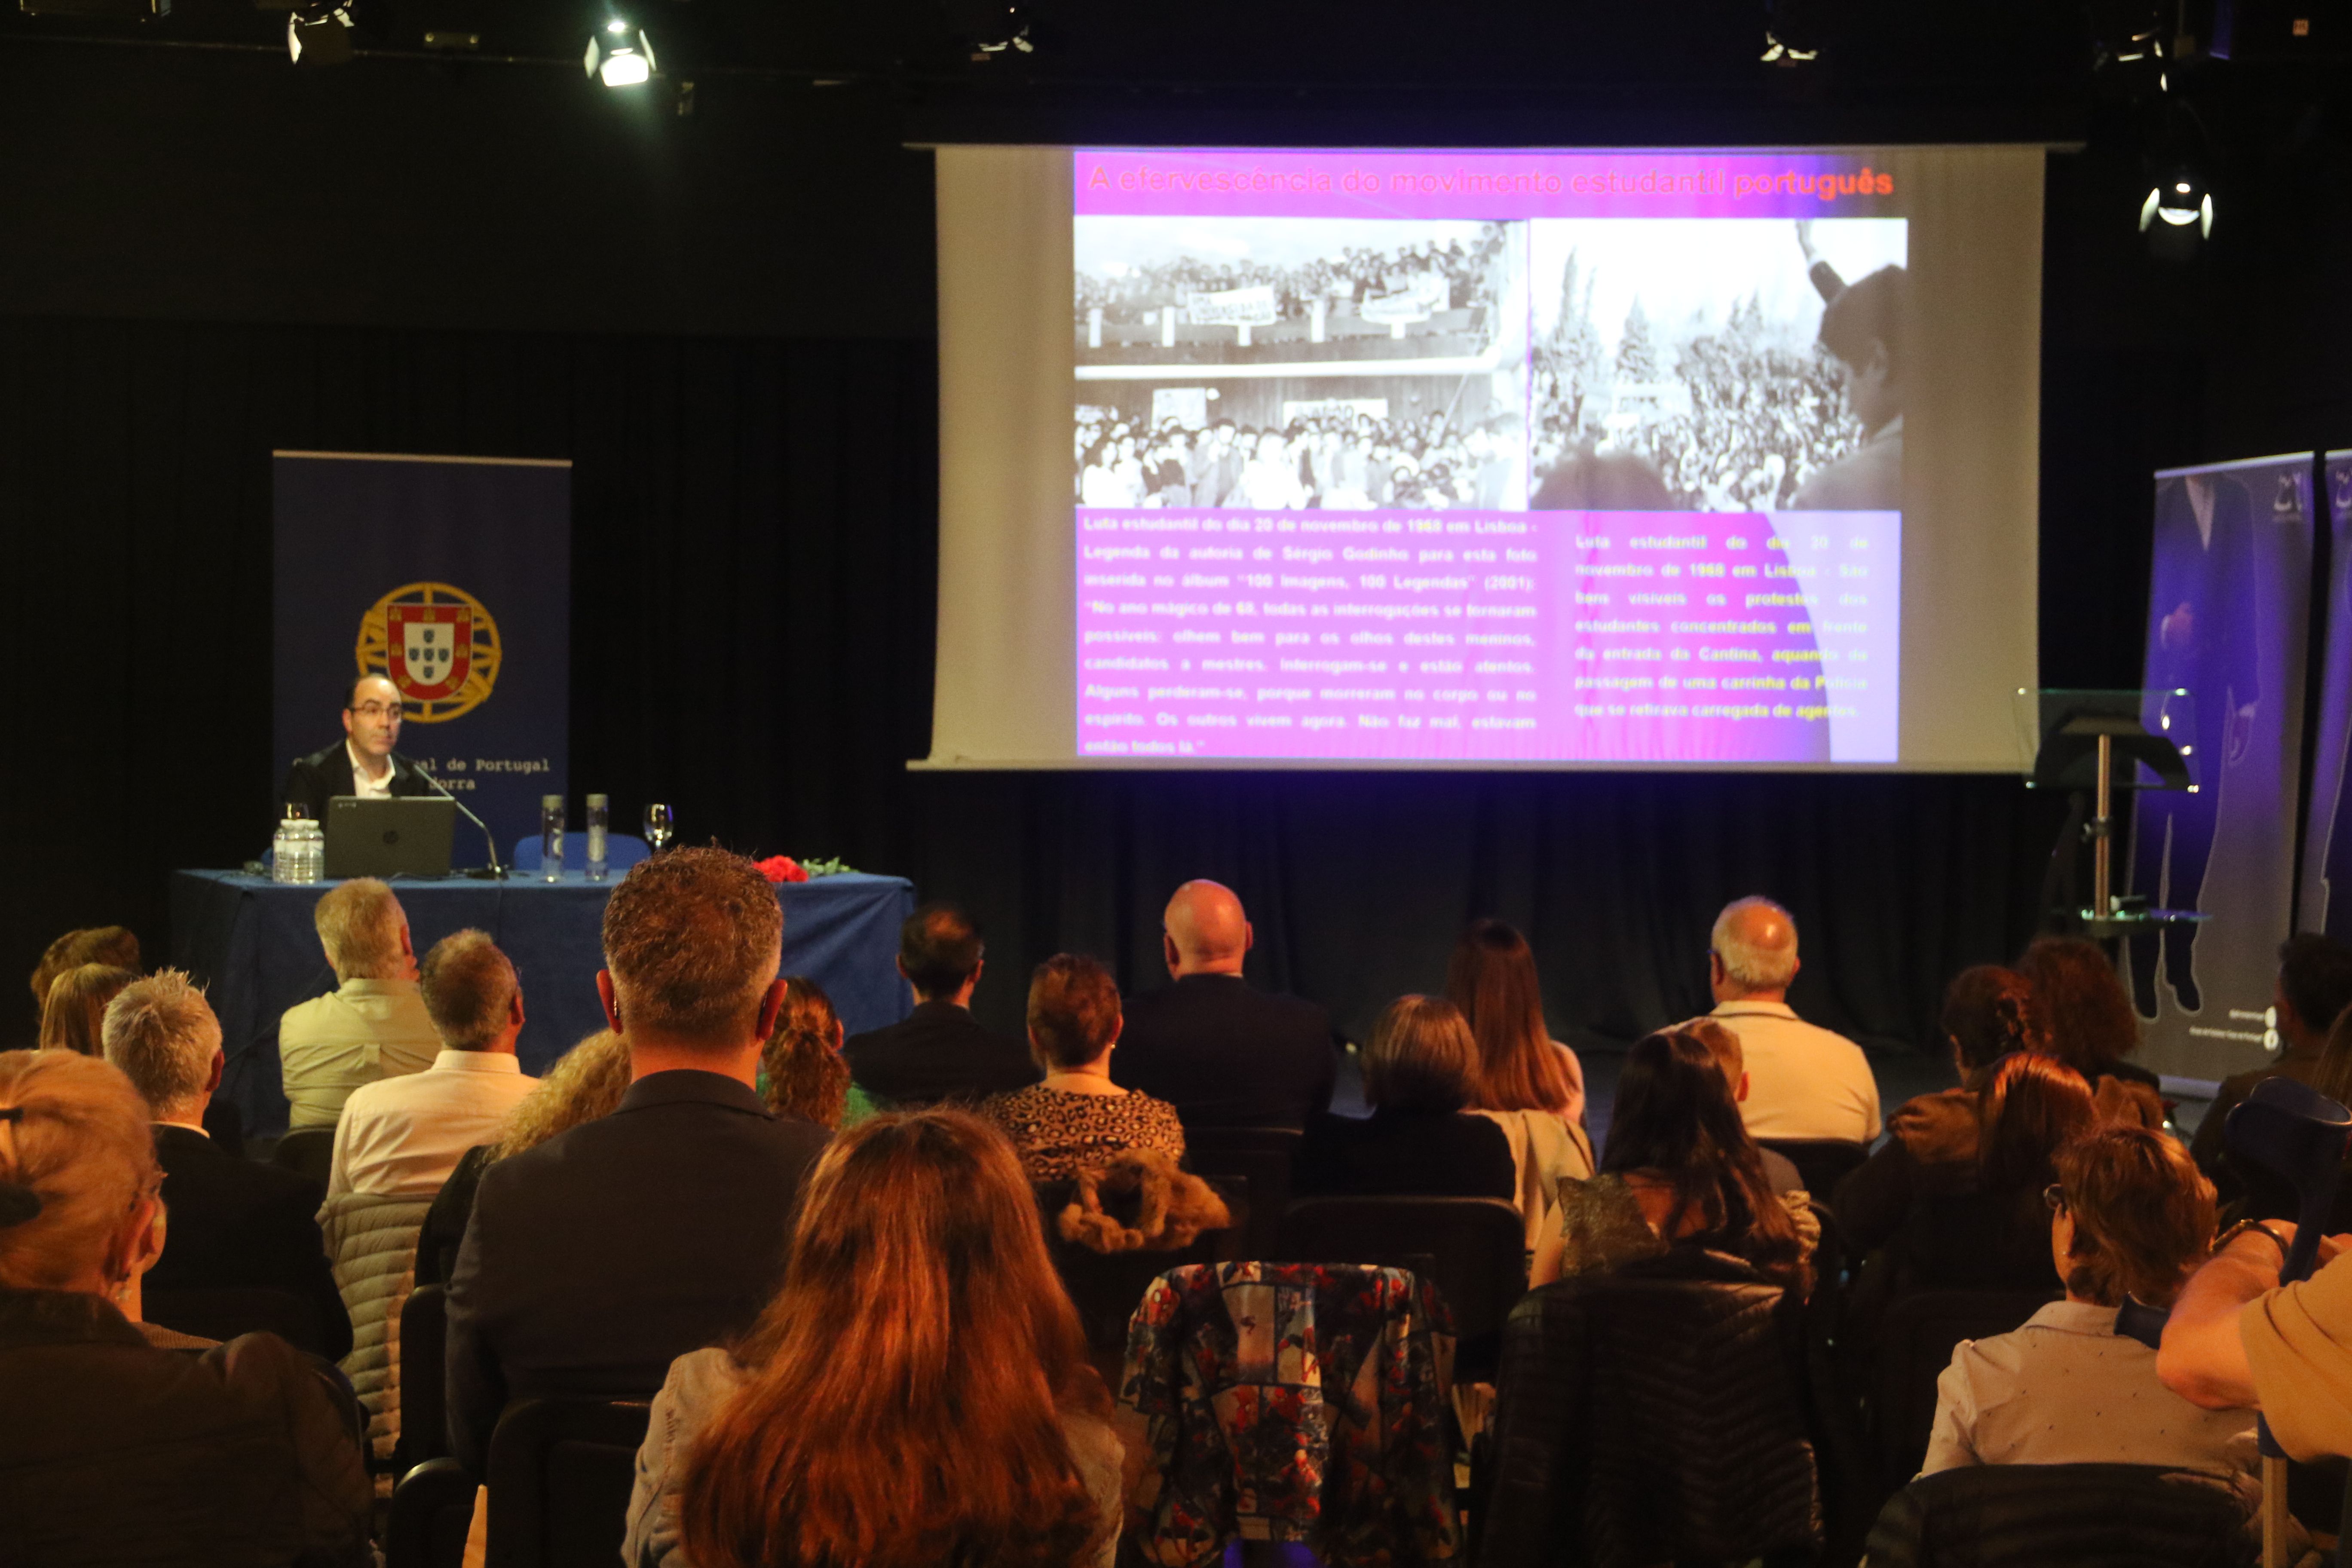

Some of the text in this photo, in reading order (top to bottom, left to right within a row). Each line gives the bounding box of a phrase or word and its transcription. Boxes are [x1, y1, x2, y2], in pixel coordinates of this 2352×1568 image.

[1089, 166, 1894, 202] A efervescência do movimento estudantil português
[1084, 517, 1118, 530] Luta
[1122, 518, 1199, 530] estudantil
[1202, 518, 1223, 531] do
[1226, 518, 1251, 531] dia
[1255, 518, 1274, 532] 20
[1277, 519, 1296, 532] de
[1301, 519, 1379, 532] novembro
[1382, 519, 1403, 532] de
[1408, 519, 1442, 533] 1968
[1446, 522, 1471, 533] em
[1475, 520, 1528, 533] Lisboa
[1576, 535, 1869, 550] Luta estudantil do dia 20 de
[1084, 545, 1151, 561] Legenda
[1160, 545, 1180, 559] da
[1189, 547, 1243, 560] autoria
[1253, 546, 1273, 560] de
[1342, 547, 1409, 561] Godinho
[1419, 550, 1454, 564] para
[1463, 548, 1497, 561] esta
[1506, 548, 1537, 562] foto
[1575, 563, 1654, 577] novembro
[1661, 563, 1681, 577] de
[1690, 563, 1726, 578] 1968
[1732, 565, 1758, 578] em
[1764, 563, 1816, 578] Lisboa
[1839, 563, 1869, 578] São
[1084, 573, 1146, 586] inserida
[1154, 576, 1174, 586] no
[1360, 575, 1387, 589] 100
[1575, 591, 1609, 606] bem
[1706, 594, 1727, 606] os
[1746, 592, 1818, 609] protestos
[1839, 593, 1868, 606] dos
[1119, 603, 1148, 614] ano
[1212, 602, 1232, 615] de
[1263, 602, 1307, 616] todas
[1311, 604, 1329, 616] as
[1444, 606, 1462, 617] se
[1466, 604, 1537, 617] tornaram
[1575, 619, 1868, 634] estudantes concentrados em frente
[1173, 630, 1221, 643] olhem
[1231, 630, 1265, 643] bem
[1275, 633, 1311, 646] para
[1320, 633, 1340, 644] os
[1350, 631, 1394, 644] olhos
[1404, 632, 1455, 645] destes
[1575, 646, 1868, 664] da entrada da Cantina, aquando da
[1084, 657, 1170, 670] candidatos
[1575, 677, 1654, 692] passagem
[1658, 676, 1678, 689] de
[1683, 678, 1717, 690] uma
[1721, 676, 1786, 690] carrinha
[1790, 676, 1810, 690] da
[1085, 684, 1139, 701] Alguns
[1257, 689, 1312, 702] porque
[1320, 689, 1396, 700] morreram
[1404, 689, 1425, 701] no
[1433, 689, 1479, 703] corpo
[1487, 690, 1508, 701] ou
[1516, 690, 1537, 701] no
[1574, 704, 1604, 718] que
[1608, 704, 1626, 716] se
[1630, 703, 1689, 717] retirava
[1692, 704, 1770, 721] carregada
[1773, 704, 1792, 717] de
[1156, 712, 1179, 726] Os
[1187, 713, 1237, 726] outros
[1246, 714, 1292, 727] vivem
[1358, 714, 1390, 728] Não
[1398, 714, 1421, 729] faz
[1472, 717, 1537, 729] estavam
[1084, 740, 1129, 753] então
[1131, 740, 1176, 754] todos
[446, 758, 467, 772] de
[475, 758, 550, 775] Portugal
